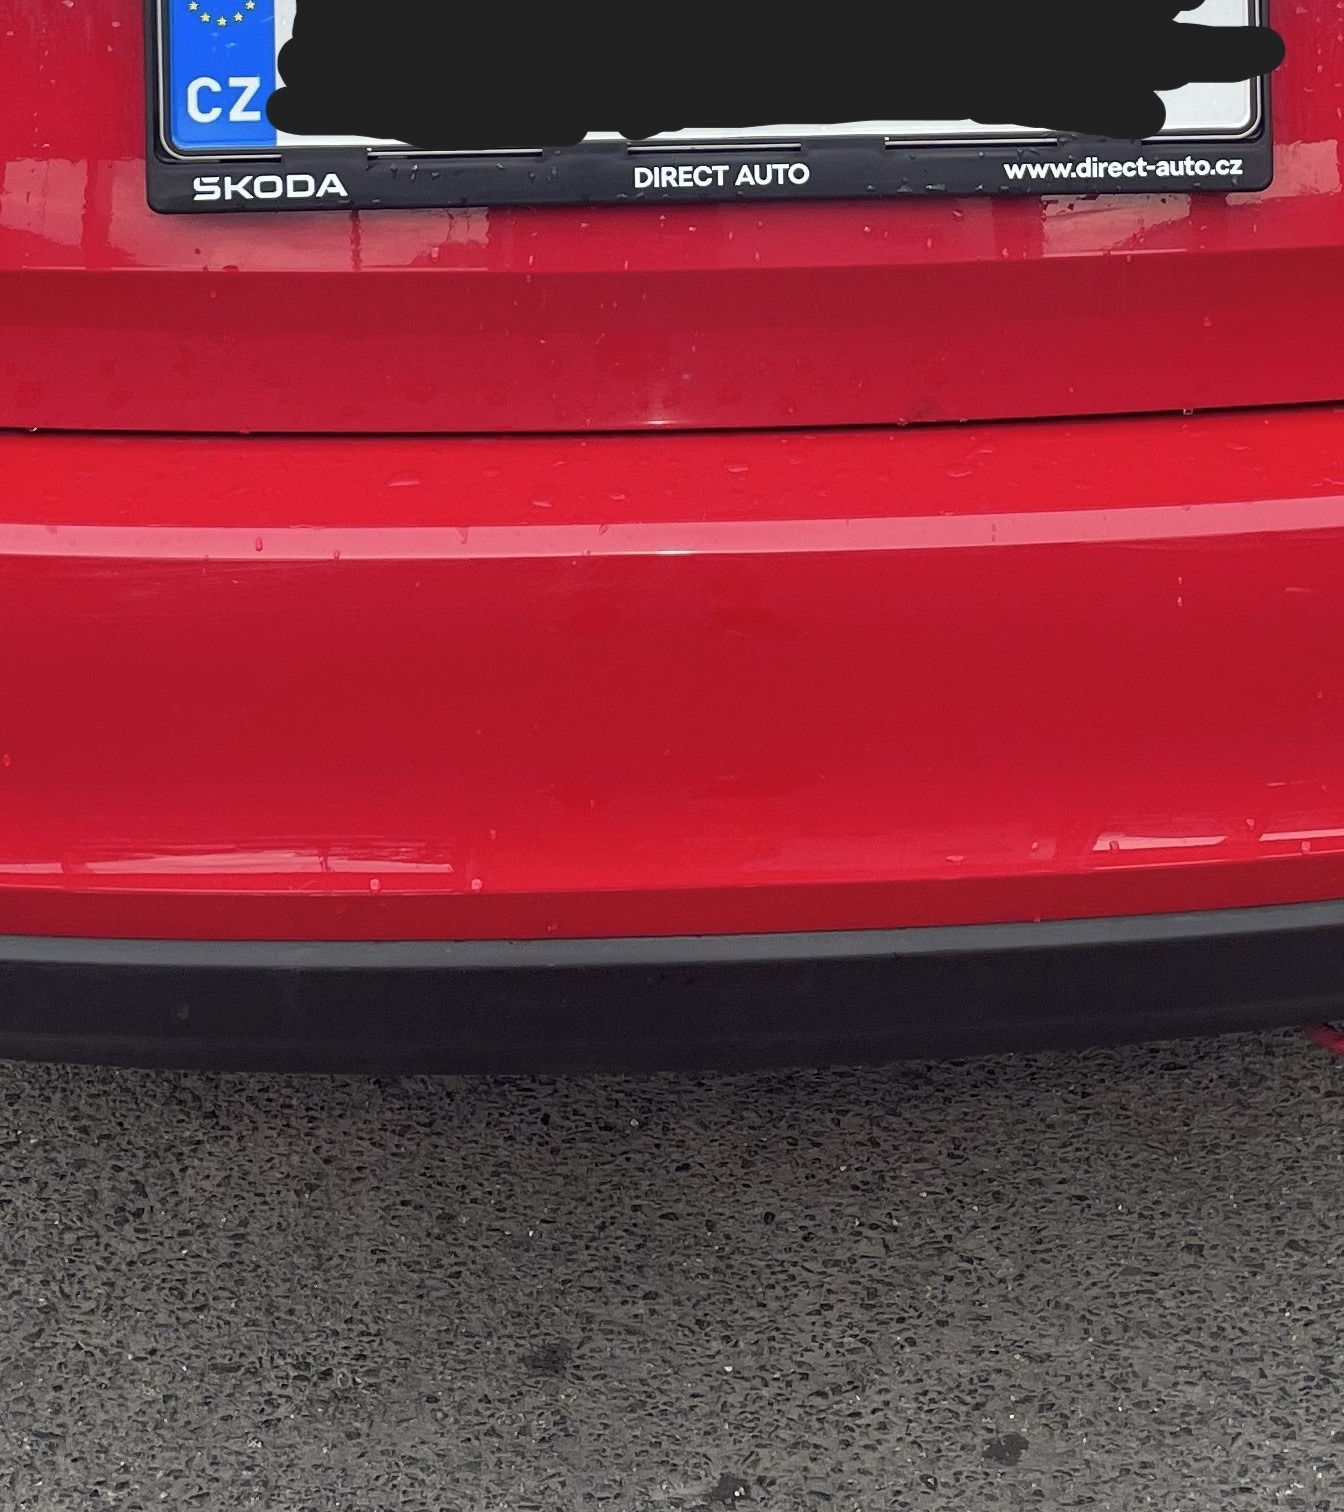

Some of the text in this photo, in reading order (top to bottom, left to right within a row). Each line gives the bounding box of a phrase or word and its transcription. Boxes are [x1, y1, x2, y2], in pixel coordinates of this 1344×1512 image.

[186, 76, 262, 124] CZ
[633, 162, 811, 189] DIRECT AUTO
[1003, 155, 1244, 181] www.direct-auto.cz
